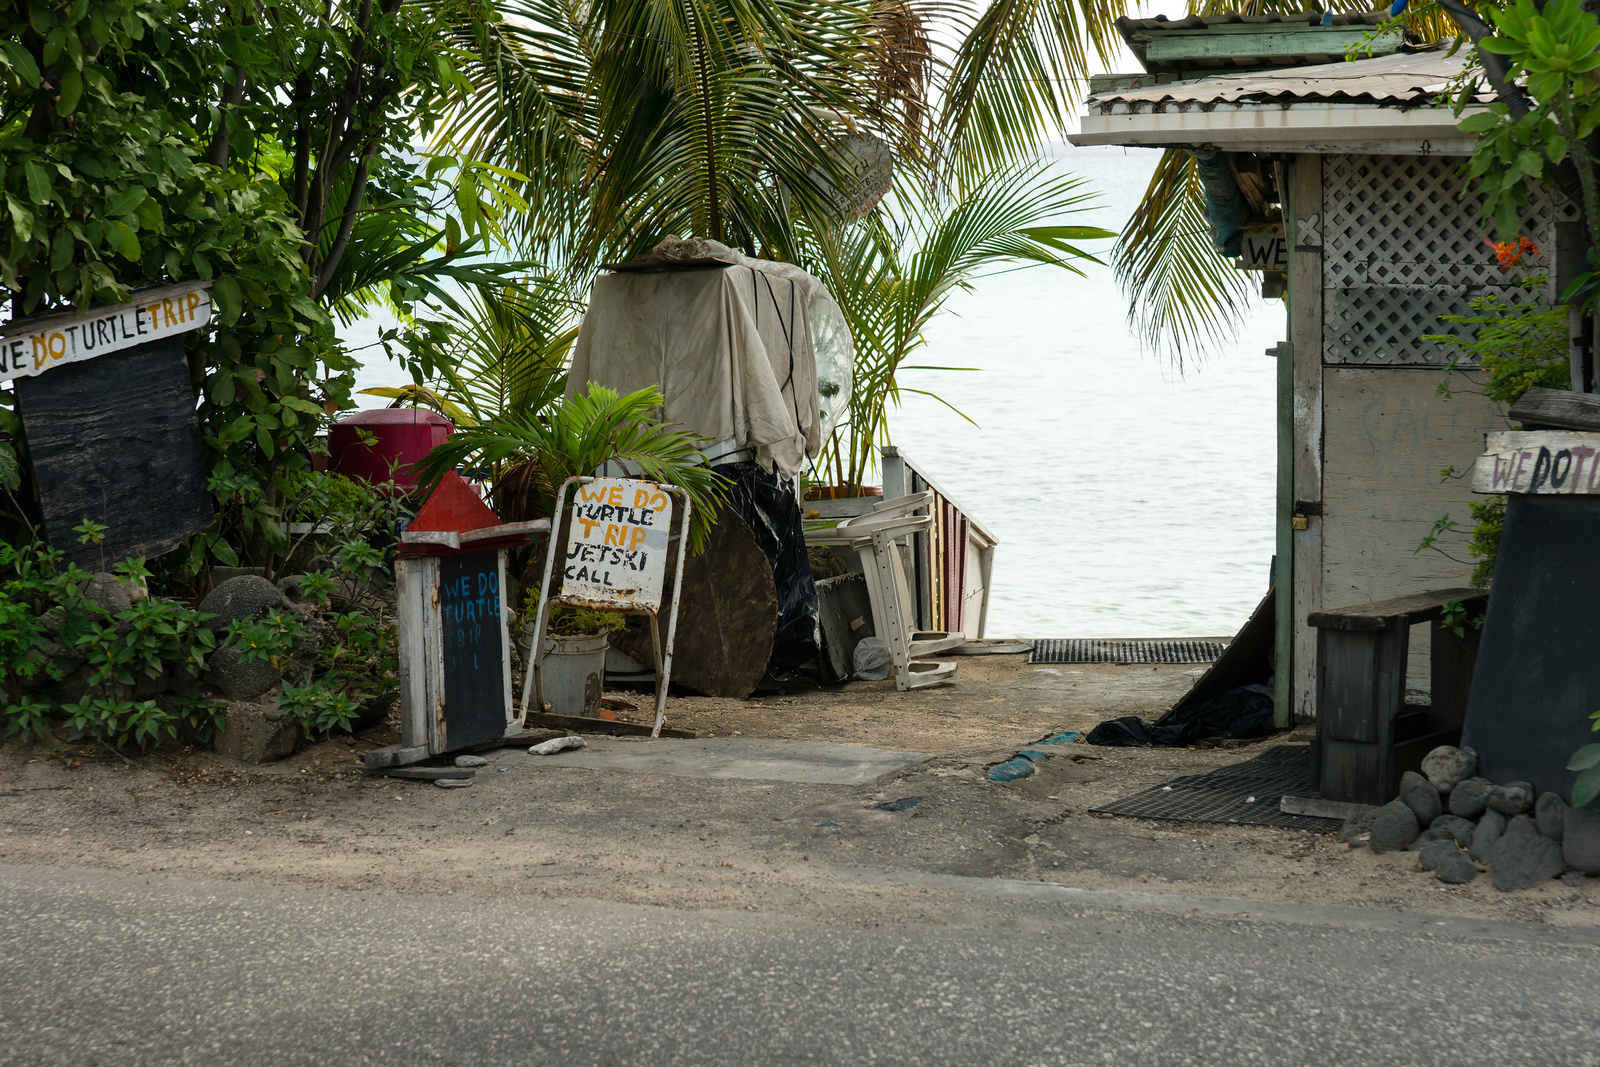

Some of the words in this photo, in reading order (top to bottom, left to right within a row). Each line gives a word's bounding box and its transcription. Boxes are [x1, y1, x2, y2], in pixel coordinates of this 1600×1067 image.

[1247, 237, 1287, 264] WE
[32, 332, 66, 370] DO
[65, 307, 147, 358] TURTLE
[147, 293, 200, 330] TRIP
[1491, 450, 1533, 491] WE
[1528, 445, 1572, 495] DO
[580, 486, 623, 507] WE
[633, 488, 668, 512] DO
[573, 503, 654, 526] TURTLE
[578, 518, 647, 552] TRIP
[566, 541, 648, 571] JETSKI
[444, 575, 471, 600] WE
[478, 570, 498, 597] DO
[564, 565, 613, 587] CALL
[443, 595, 500, 624] TURTLE
